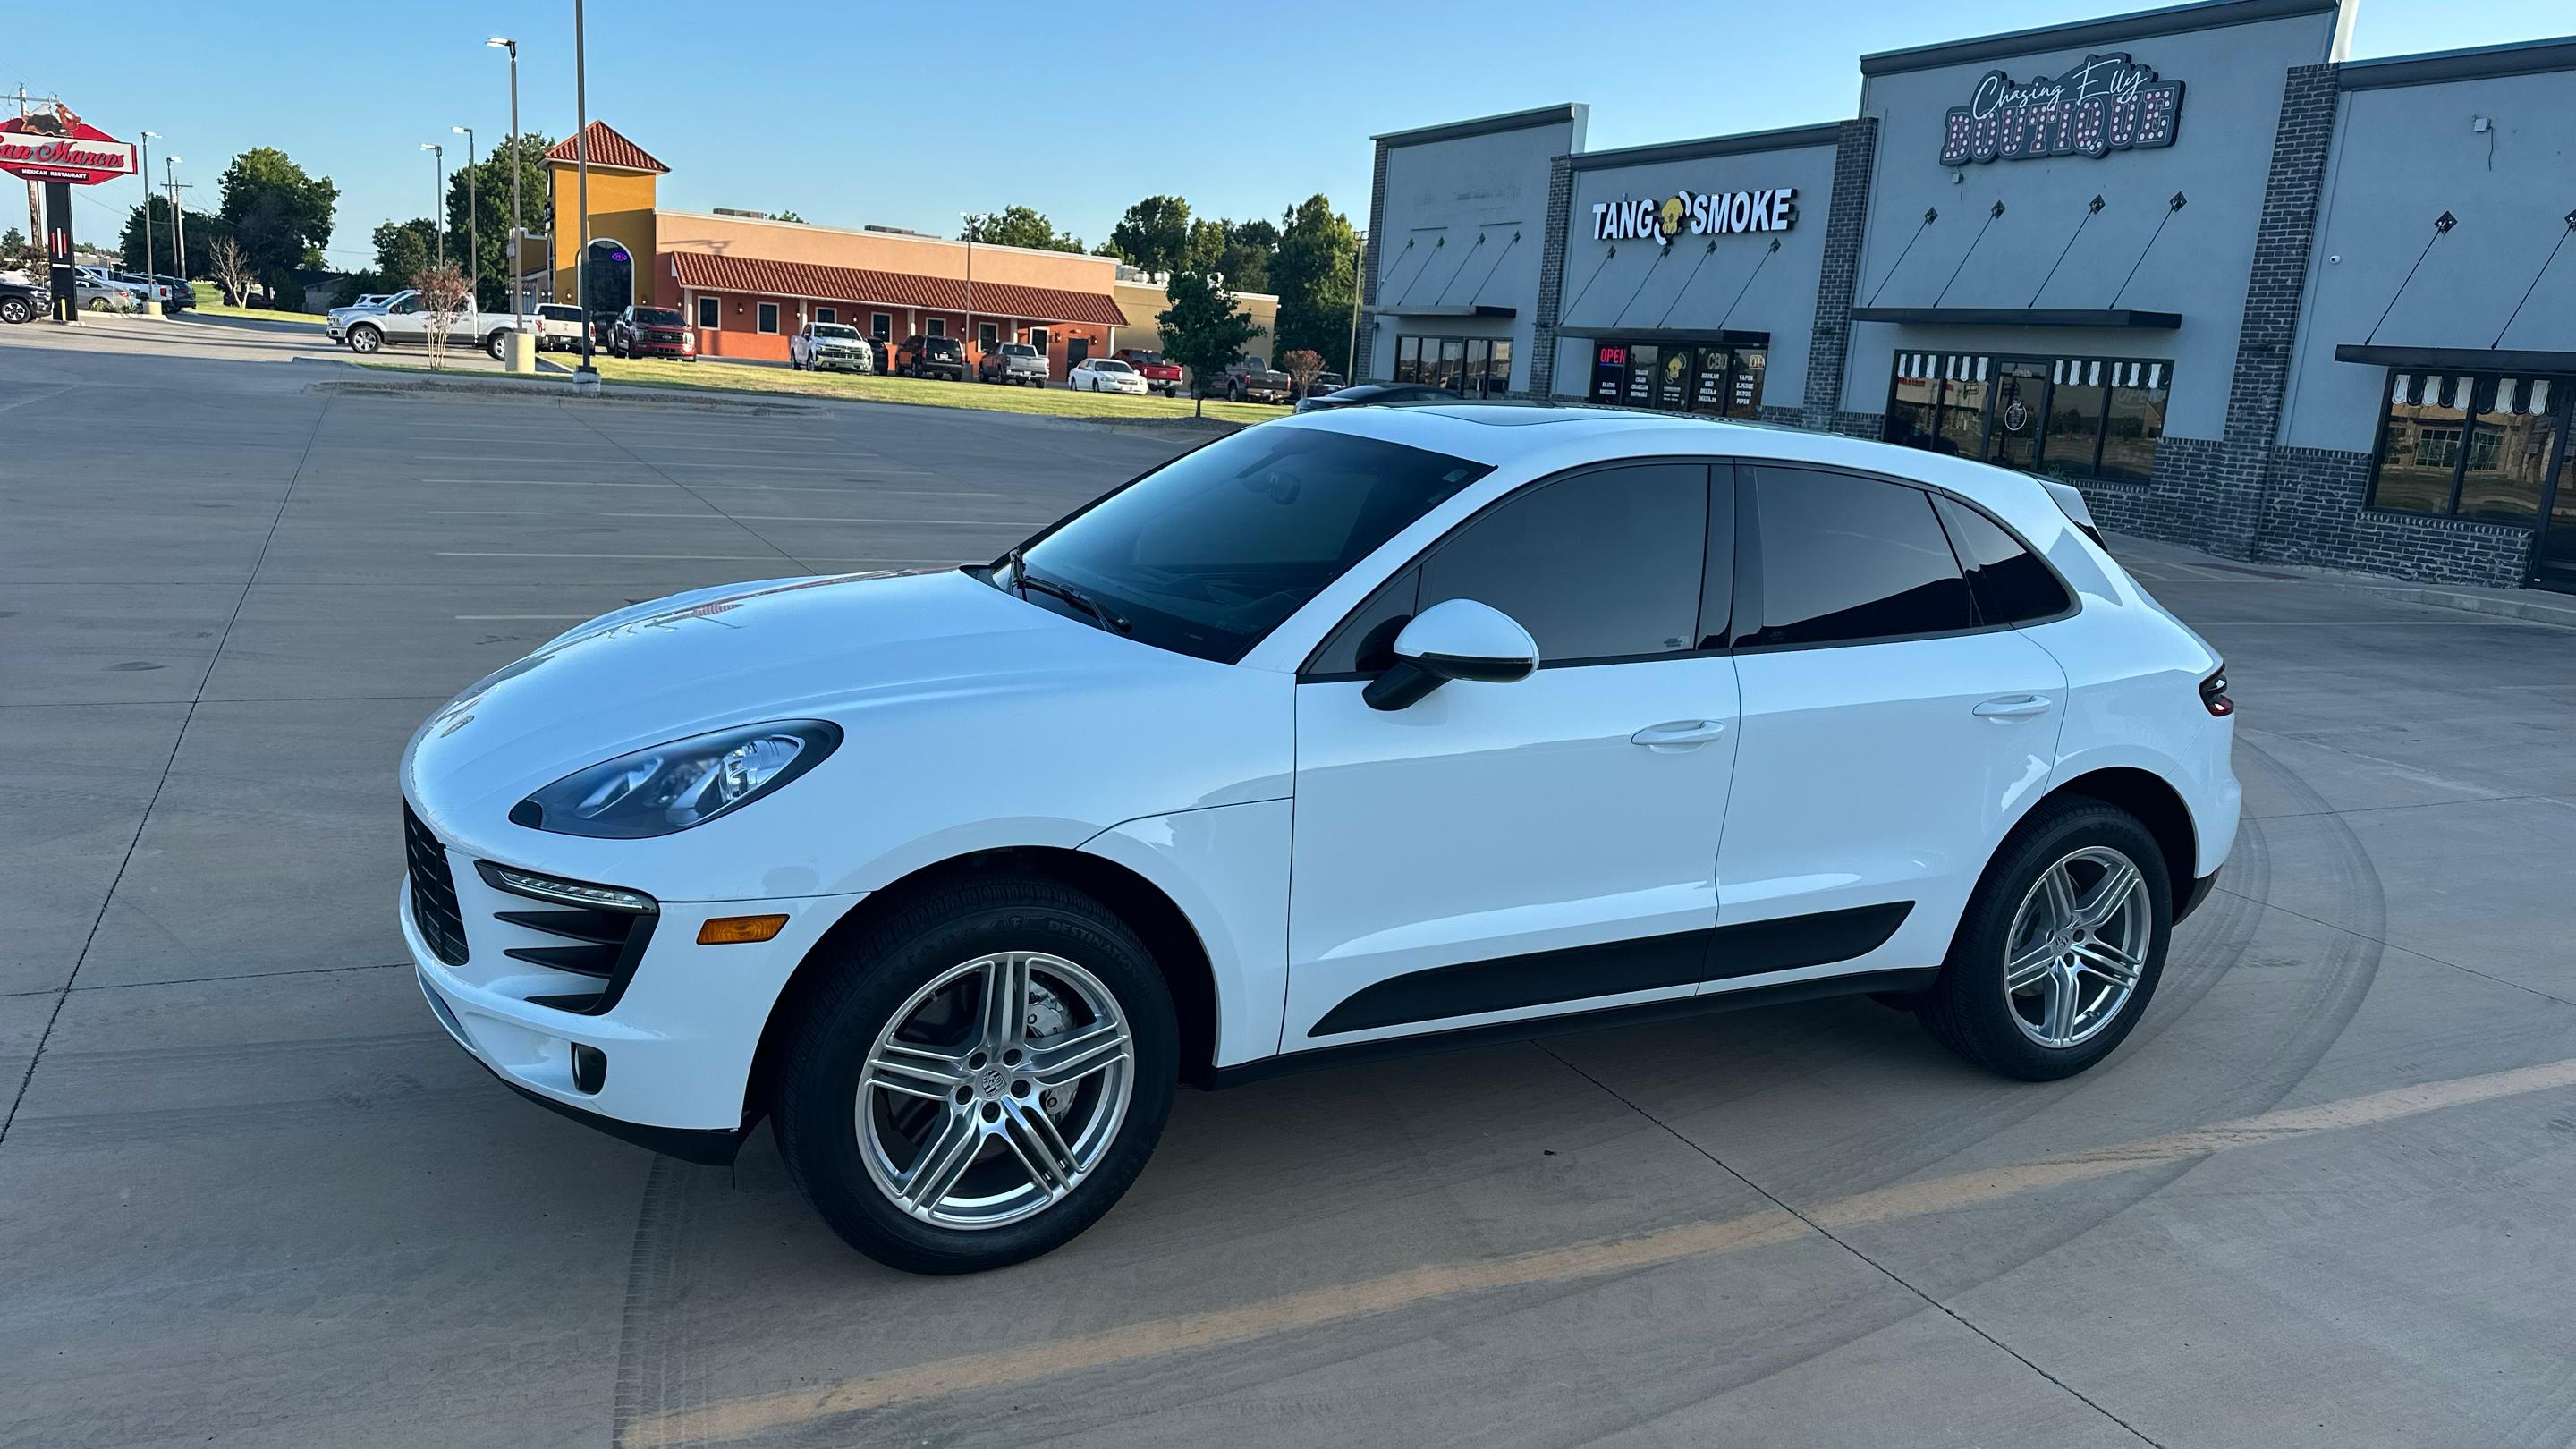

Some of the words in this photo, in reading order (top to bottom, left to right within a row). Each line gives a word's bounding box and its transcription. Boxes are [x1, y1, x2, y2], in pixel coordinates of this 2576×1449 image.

[1973, 76, 2065, 120] Chasing
[2072, 59, 2148, 105] Elly
[1943, 86, 2174, 160] BOUTIQUE
[0, 136, 32, 159] an
[36, 140, 125, 168] Marcos
[21, 168, 47, 176] MEXICAN
[50, 171, 87, 180] RESTAURANT
[1690, 188, 1793, 235] SMOKE
[1600, 347, 1626, 364] OPEN
[1707, 352, 1729, 370] CBD
